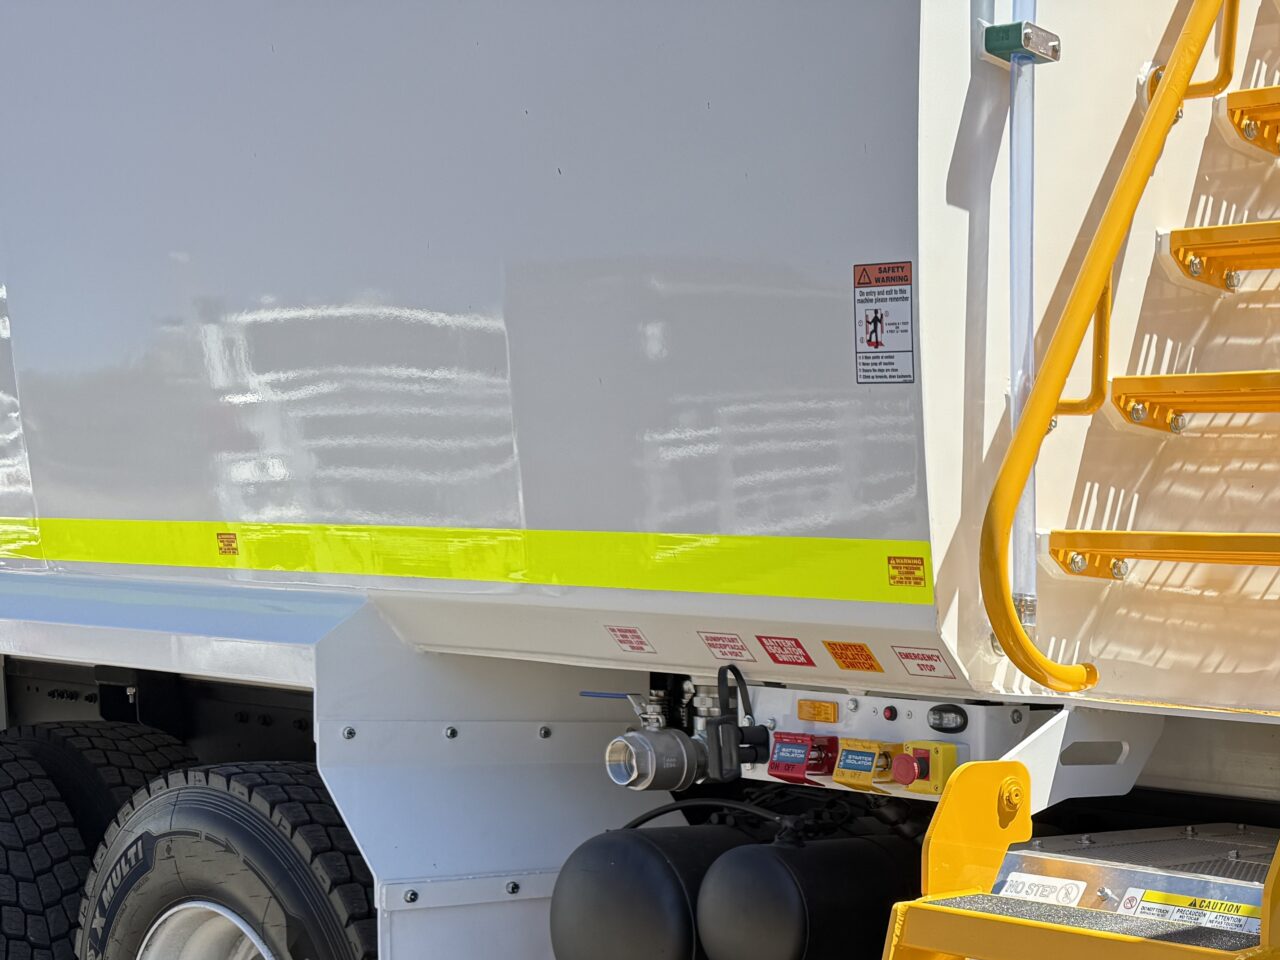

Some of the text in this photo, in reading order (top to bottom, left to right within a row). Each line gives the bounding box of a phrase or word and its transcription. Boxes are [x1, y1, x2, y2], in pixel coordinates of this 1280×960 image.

[878, 266, 904, 274] SAFETY
[875, 275, 908, 283] WARNING
[704, 636, 740, 644] JUMPSTART
[762, 638, 798, 648] BATTERY
[707, 642, 746, 651] RECEPTACLE
[766, 646, 806, 656] ISOLATOR
[828, 642, 868, 653] STARTER
[776, 654, 808, 664] SWITCH
[832, 651, 874, 662] ISOLATOR
[898, 652, 942, 662] EMERGENCY
[842, 660, 878, 671] SWITCH
[917, 664, 936, 672] STOP
[102, 840, 144, 908] MULTI
[1005, 880, 1058, 898] NO STEP
[1199, 899, 1242, 914] CAUTION
[1214, 914, 1242, 924] ATTENTION
